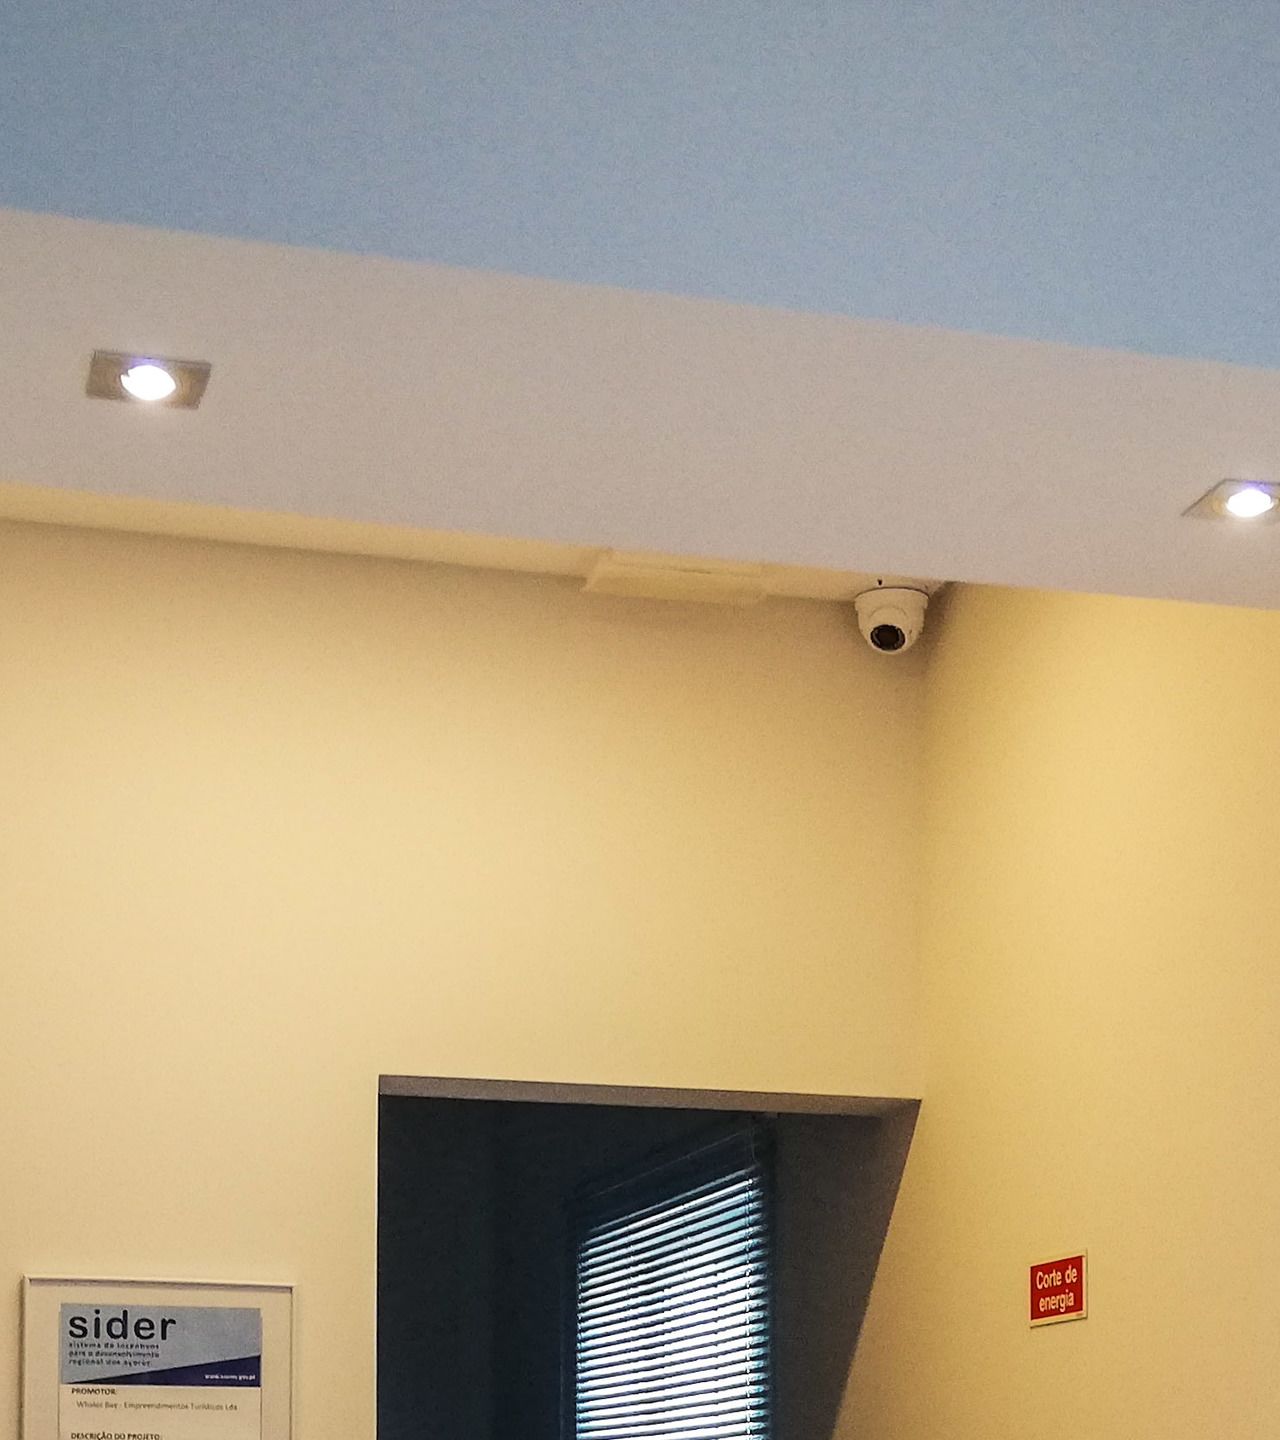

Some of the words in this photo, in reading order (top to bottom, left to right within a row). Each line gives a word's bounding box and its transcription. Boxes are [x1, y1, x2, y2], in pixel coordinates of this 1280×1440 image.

[1036, 1269, 1062, 1290] Corte
[1065, 1265, 1078, 1284] de
[1039, 1289, 1075, 1313] energia
[68, 1309, 177, 1340] sider
[68, 1358, 104, 1367] regional
[70, 1431, 113, 1440] DESCRIÇÃO
[114, 1433, 126, 1440] DO
